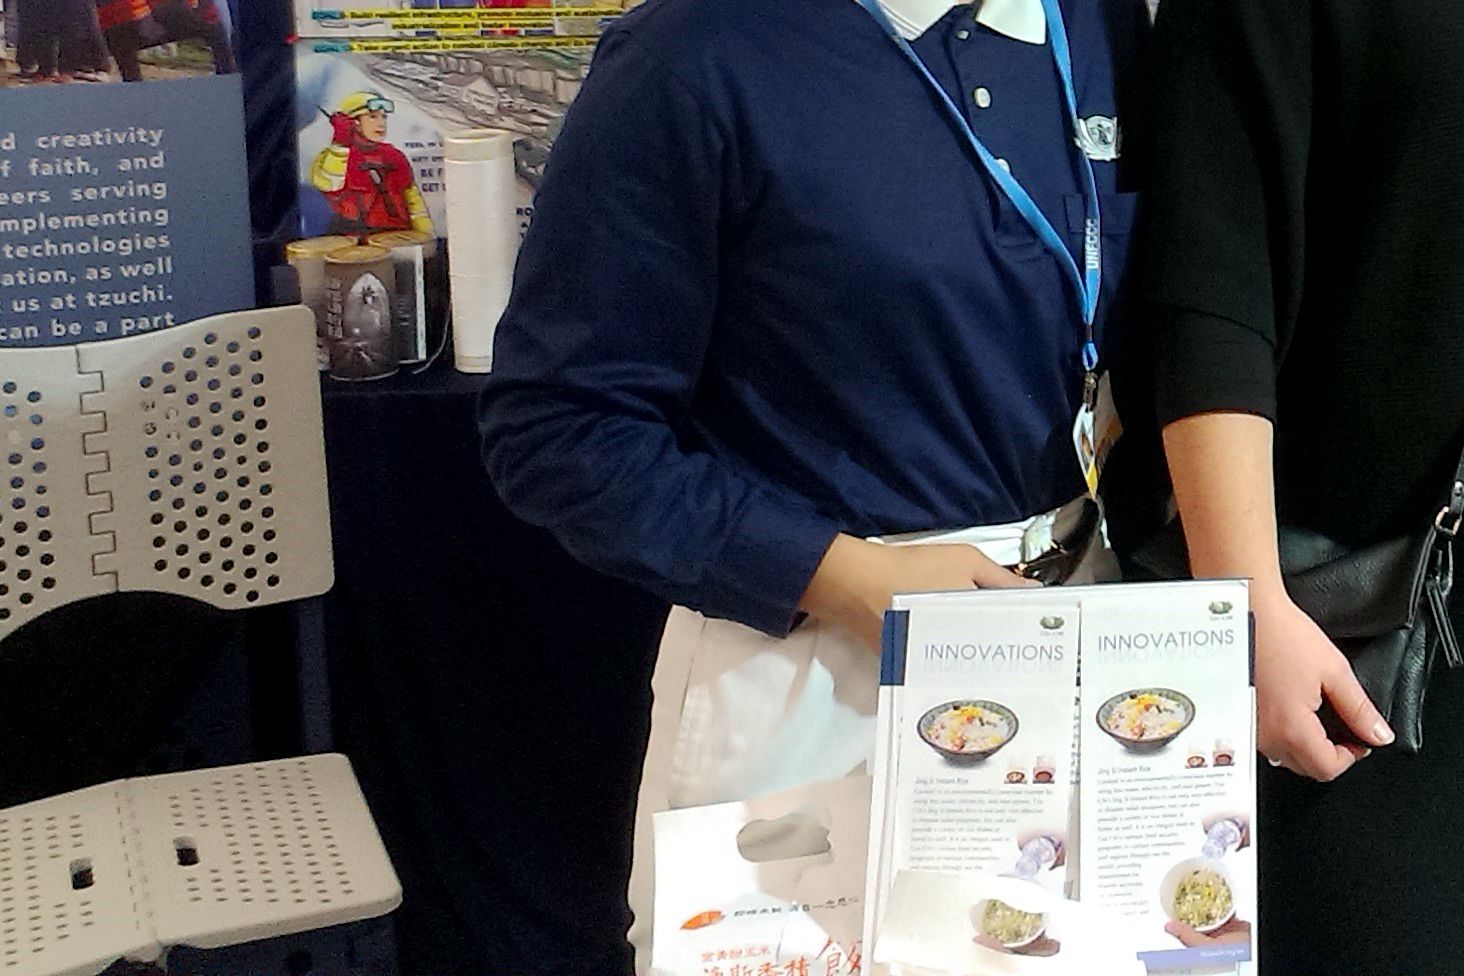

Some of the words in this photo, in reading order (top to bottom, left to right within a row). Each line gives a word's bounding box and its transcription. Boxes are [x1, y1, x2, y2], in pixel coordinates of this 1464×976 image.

[36, 126, 164, 148] creativity
[27, 155, 99, 176] faith,
[117, 150, 165, 172] and
[0, 189, 51, 206] eers
[71, 180, 168, 202] serving
[0, 206, 170, 235] mplementing
[516, 207, 532, 216] RO
[3, 233, 171, 259] technologies
[1, 267, 77, 286] ation,
[86, 266, 112, 281] as
[119, 256, 174, 277] well
[13, 298, 40, 313] us
[51, 292, 76, 310] at
[86, 284, 173, 307] tzuchi.
[0, 325, 39, 340] can
[52, 318, 83, 337] be
[95, 320, 109, 335] a
[121, 311, 176, 336] part
[924, 643, 1065, 662] INNOVATIONS
[1098, 628, 1235, 652] INNOVATIONS
